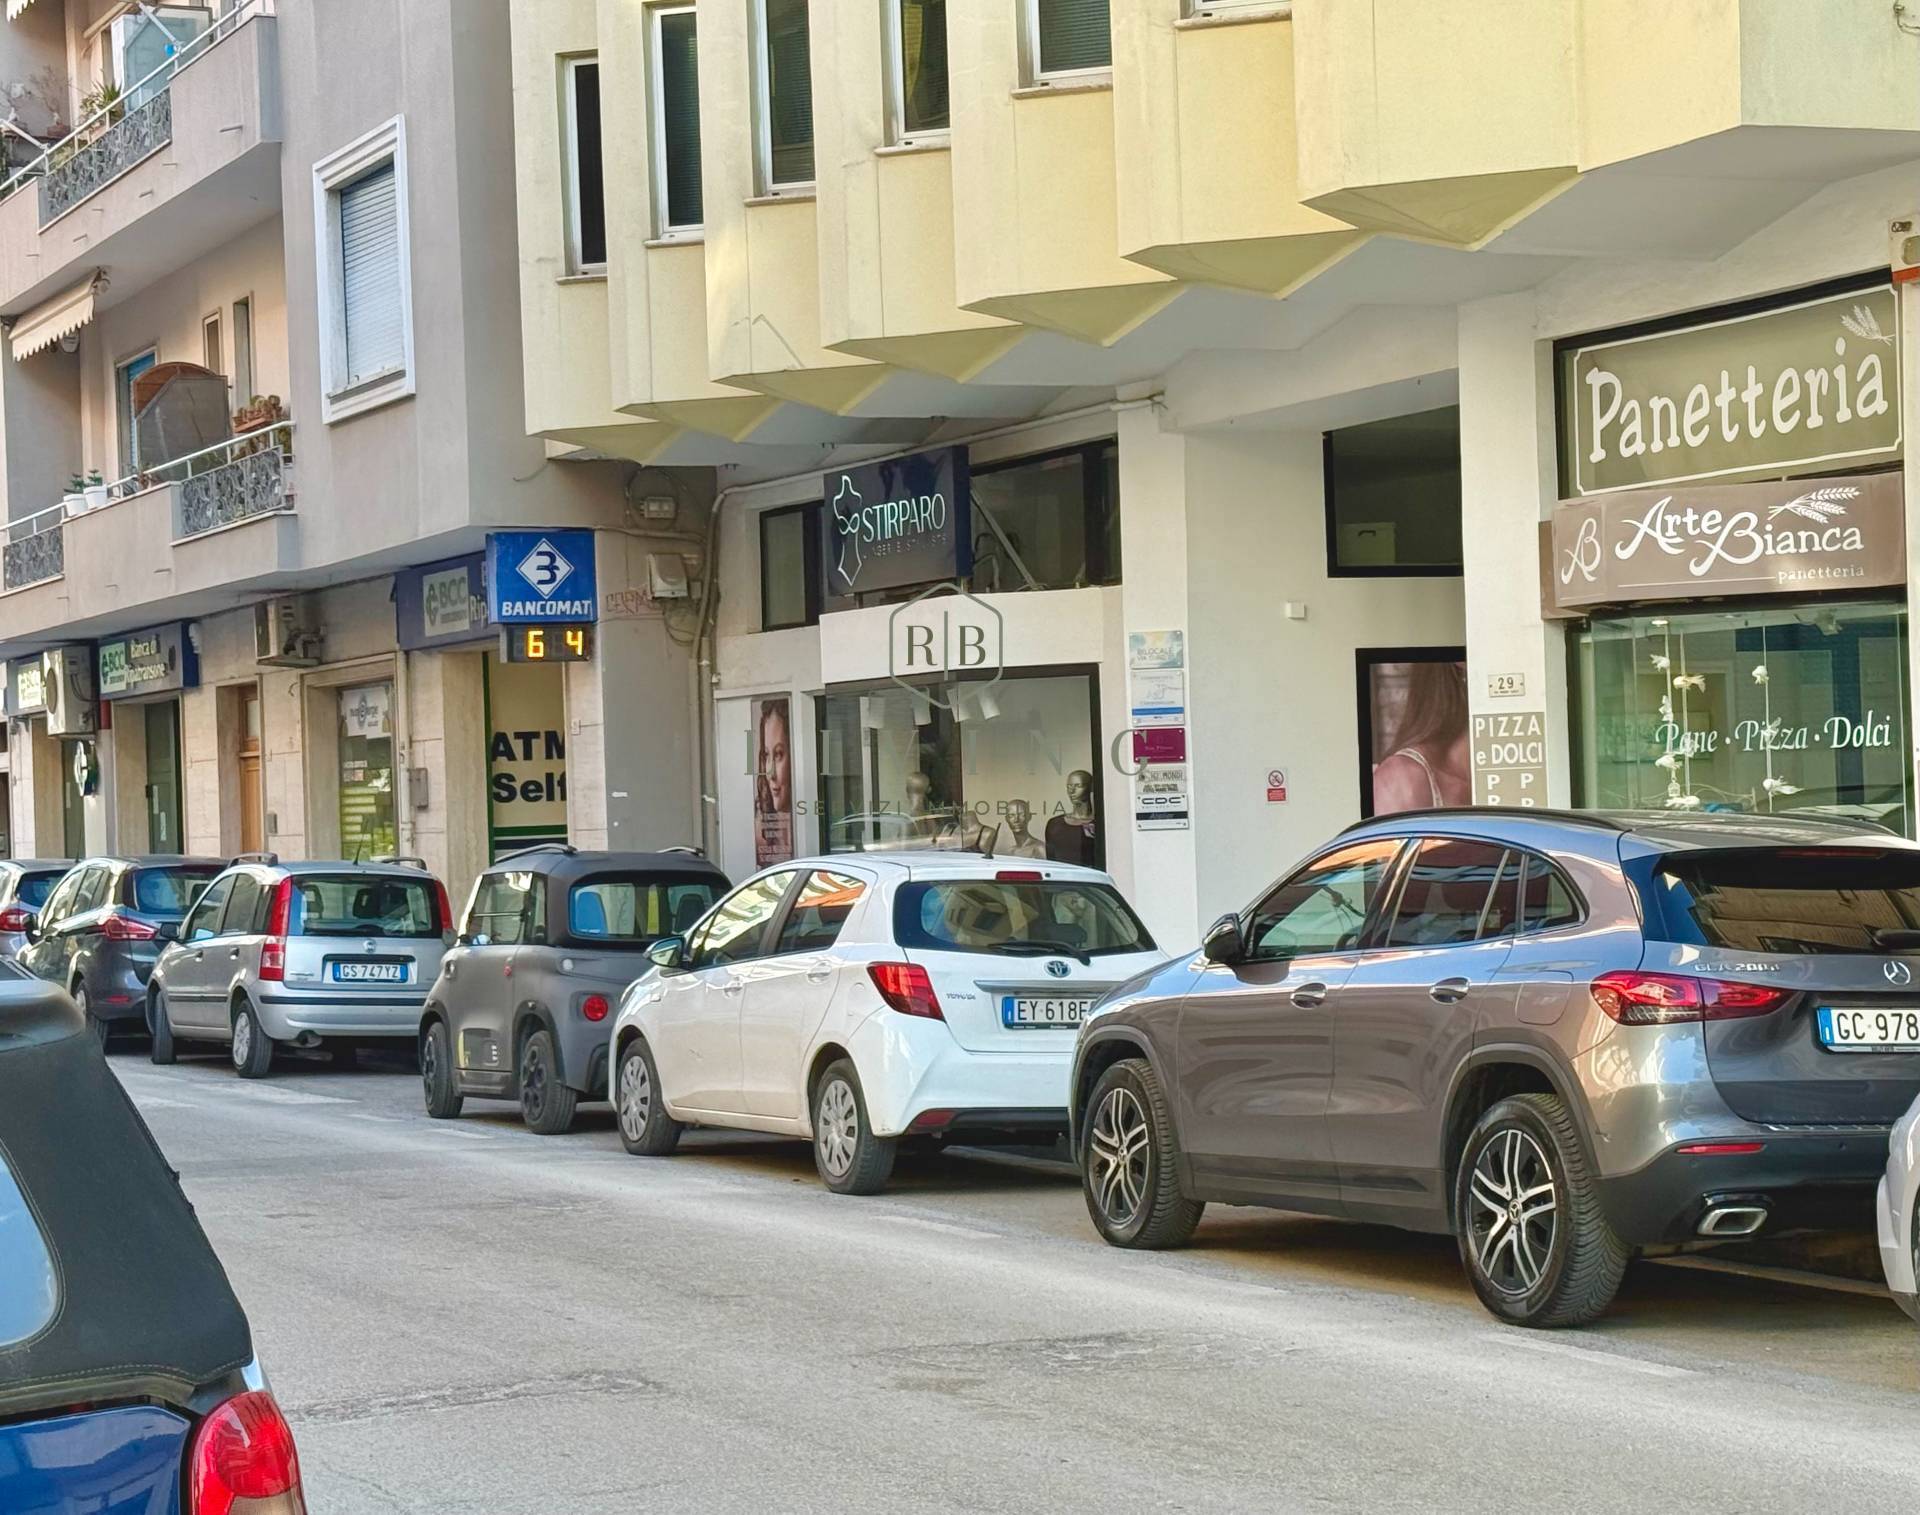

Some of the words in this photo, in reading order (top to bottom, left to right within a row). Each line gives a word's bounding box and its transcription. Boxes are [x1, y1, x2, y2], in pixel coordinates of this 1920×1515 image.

[1585, 336, 1889, 464] Panetteria
[862, 493, 946, 543] STIRPARO
[1615, 496, 1723, 556] Arte
[1688, 511, 1865, 577] Bianca
[1777, 564, 1865, 585] panetteria
[439, 576, 467, 604] BCC
[502, 600, 592, 617] BANCOMAT
[527, 630, 545, 658] 6
[565, 630, 583, 656] 4
[1497, 677, 1514, 691] 29
[1475, 715, 1542, 738] PIZZA
[1655, 723, 1718, 757] Pane
[1735, 720, 1809, 752] Pizza
[1823, 710, 1891, 749] Dolci
[492, 730, 566, 762] ATM
[1476, 750, 1487, 765] e
[1491, 742, 1543, 765] DOLCI
[493, 771, 567, 803] Self
[1141, 797, 1181, 805] CDC
[360, 965, 399, 979] 747YZ
[1018, 1001, 1038, 1020] EY
[1836, 1012, 1866, 1040] GC
[1875, 1012, 1920, 1041] 978
